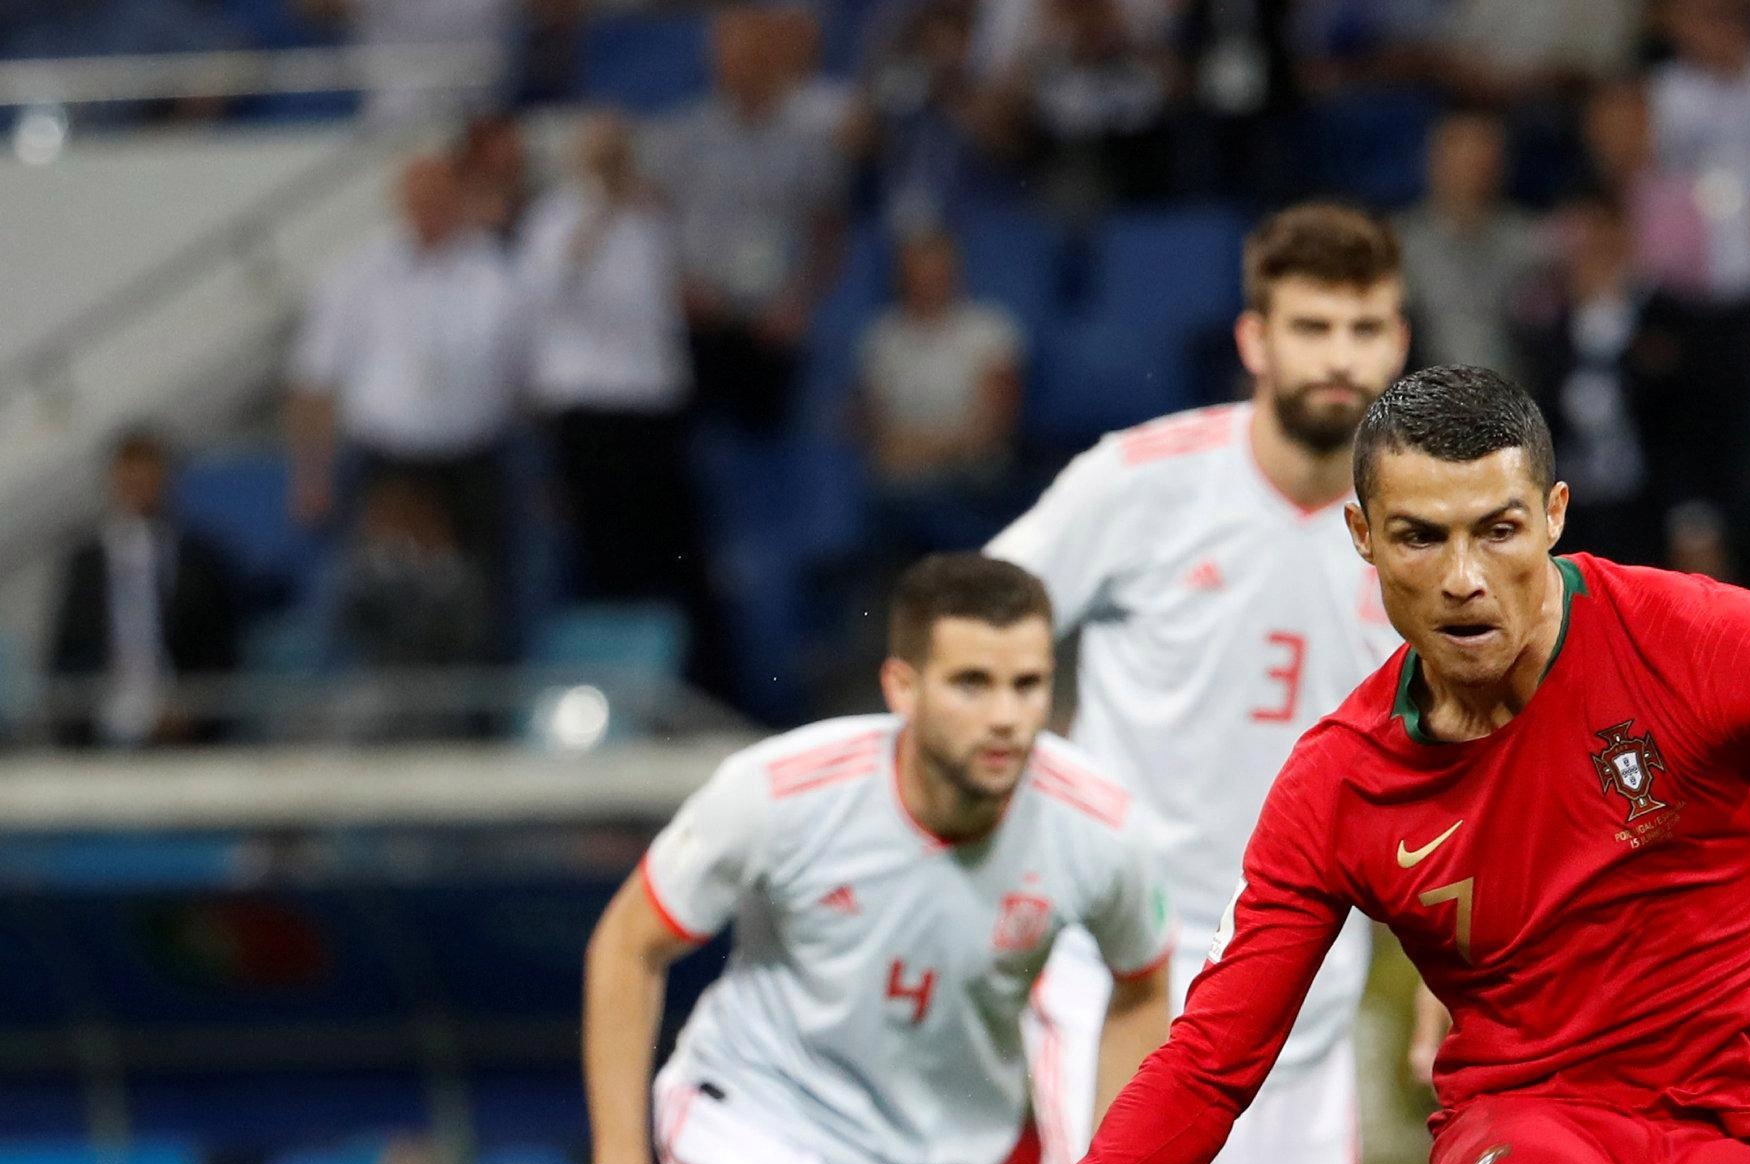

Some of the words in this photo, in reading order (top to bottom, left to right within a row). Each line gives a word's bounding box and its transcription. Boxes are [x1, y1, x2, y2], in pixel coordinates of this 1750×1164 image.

[1250, 632, 1307, 721] 3
[1630, 837, 1640, 849] 15
[1419, 877, 1474, 966] 7
[885, 958, 938, 1024] 4
